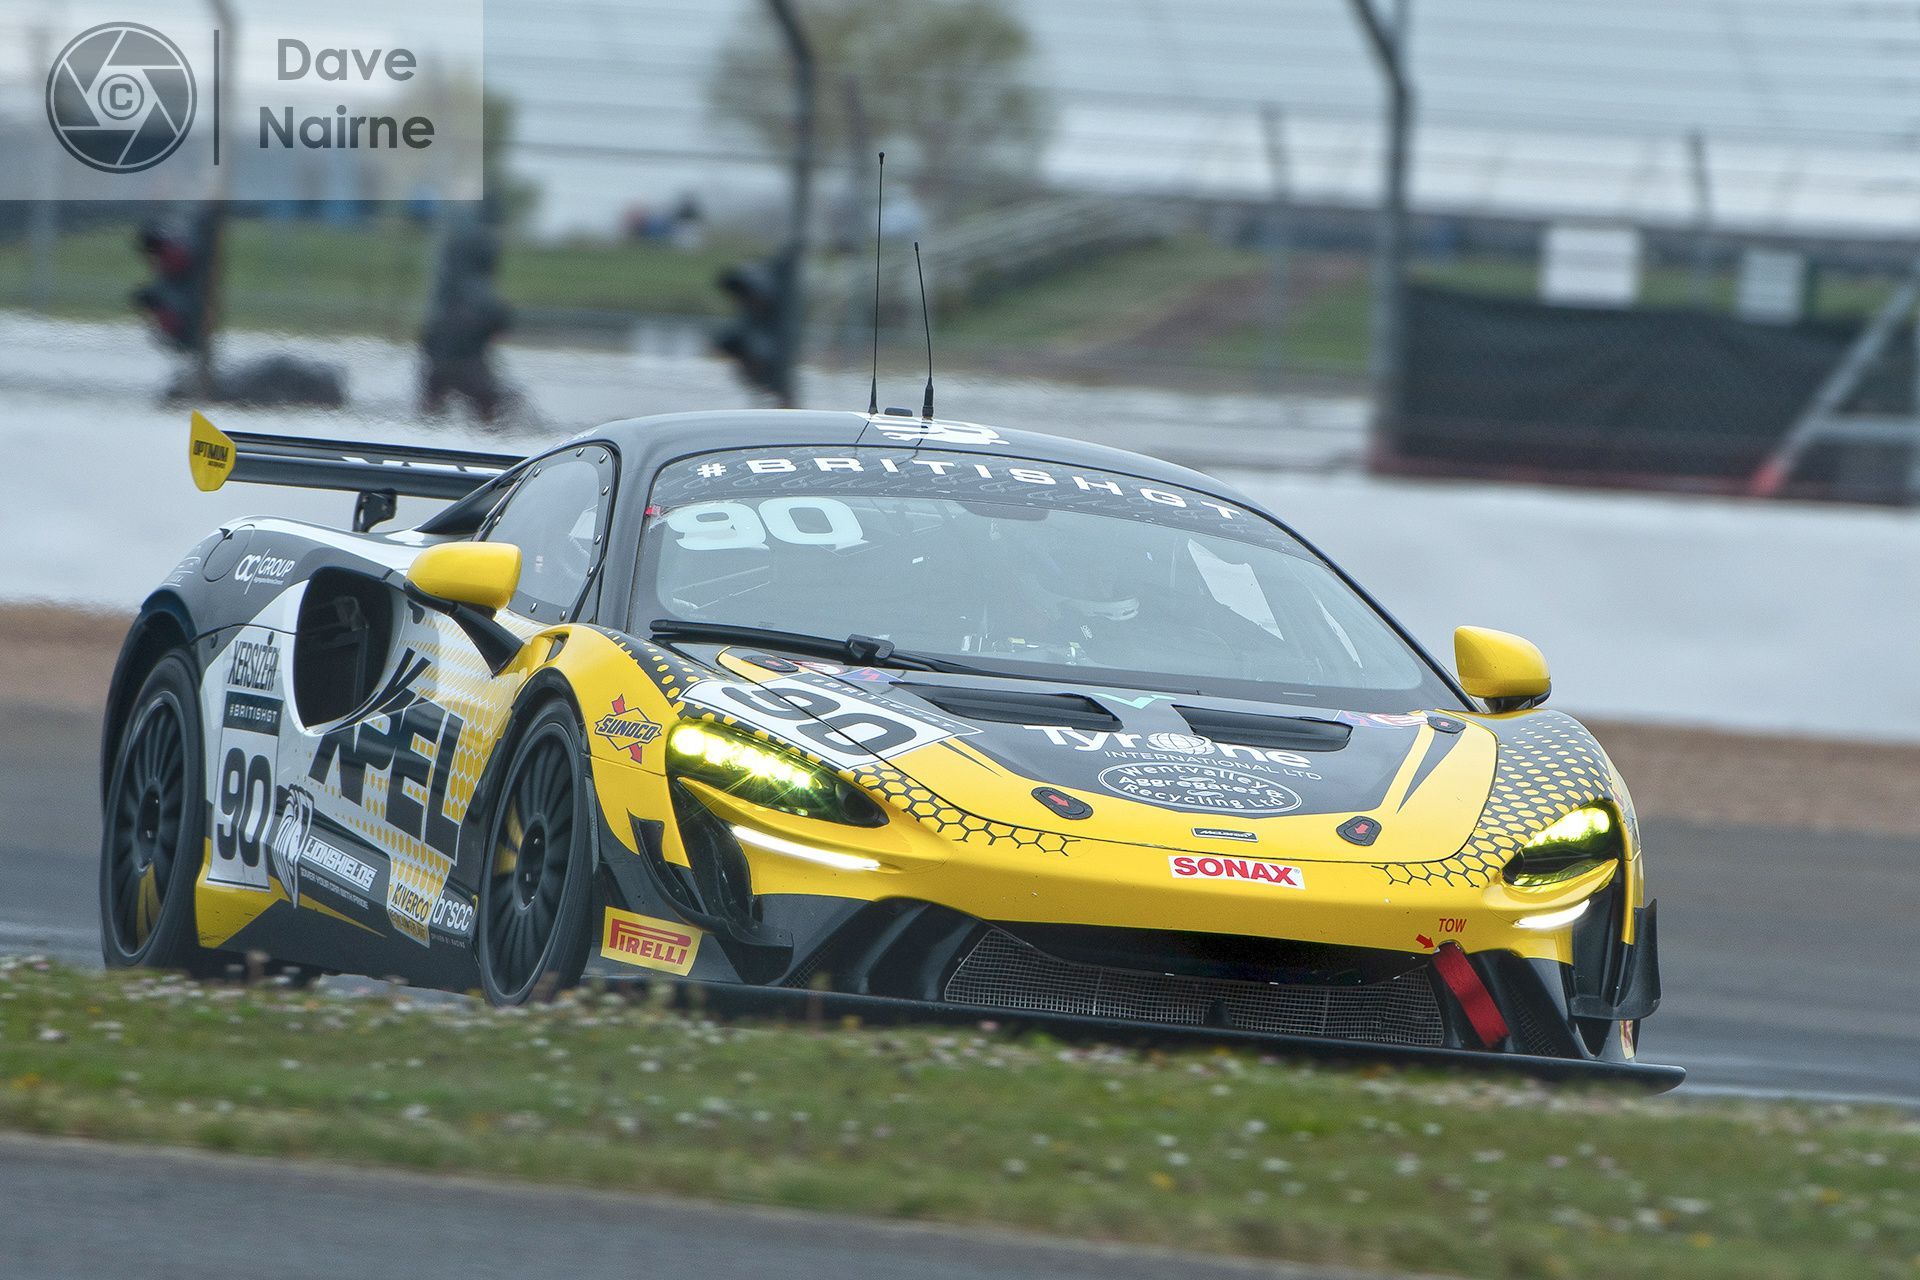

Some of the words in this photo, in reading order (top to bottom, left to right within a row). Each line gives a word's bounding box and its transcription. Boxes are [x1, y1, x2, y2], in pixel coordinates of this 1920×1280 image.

[666, 496, 867, 551] 90
[258, 557, 295, 578] GROUP
[229, 703, 277, 723] #BRITISHGT
[721, 686, 917, 756] 90
[600, 717, 660, 742] SUNOCO
[1104, 750, 1279, 774] INTERNATIONAL
[1283, 768, 1322, 781] LTD
[1117, 764, 1270, 790] Wentvalley
[1118, 776, 1261, 795] Aggregates
[1265, 788, 1285, 800] &
[1123, 784, 1245, 809] Recycling
[1248, 797, 1285, 808] Ltd
[216, 747, 272, 868] 90
[302, 838, 377, 889] LIONSHIELDS
[1173, 857, 1297, 887] SONAX
[392, 882, 429, 922] KIVERCO
[433, 889, 473, 932] brscc
[1438, 918, 1467, 933] TOW
[609, 918, 692, 965] PIRELLI
